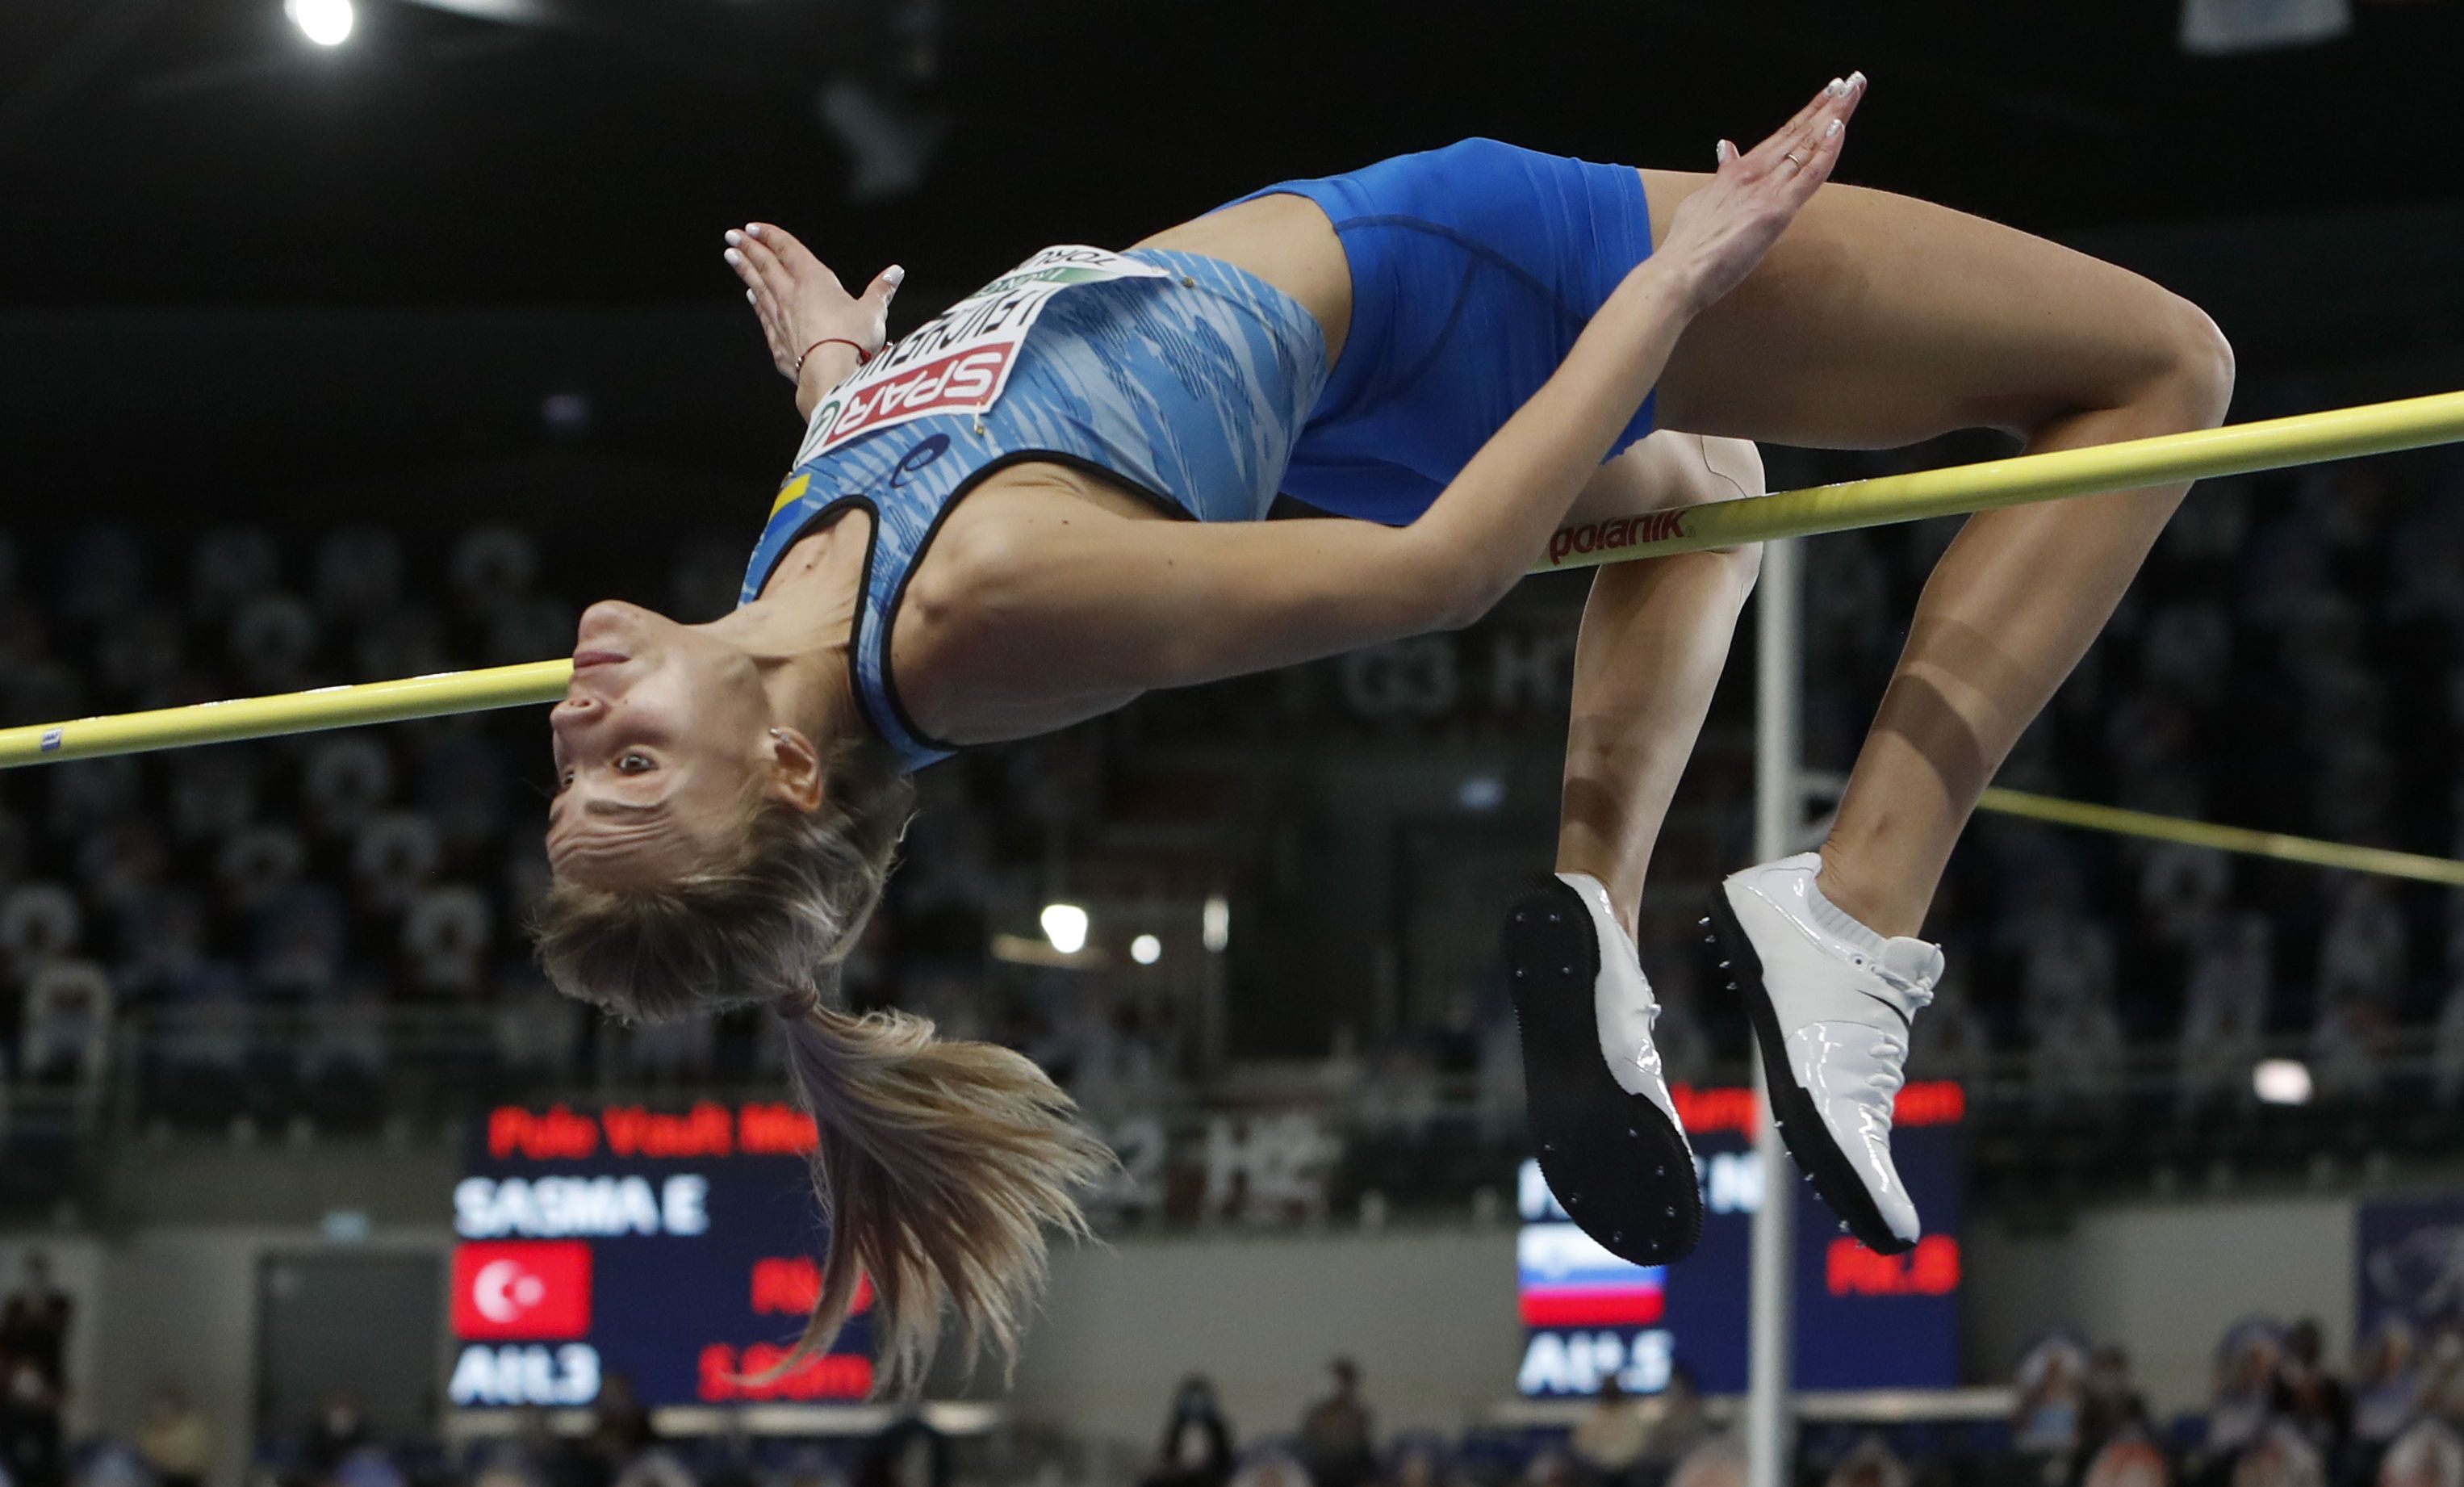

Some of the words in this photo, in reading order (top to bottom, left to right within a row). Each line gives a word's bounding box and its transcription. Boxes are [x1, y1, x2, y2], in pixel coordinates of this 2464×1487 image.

[834, 352, 1002, 435] SPAR
[1550, 509, 1688, 565] polanik
[661, 1173, 710, 1237] E
